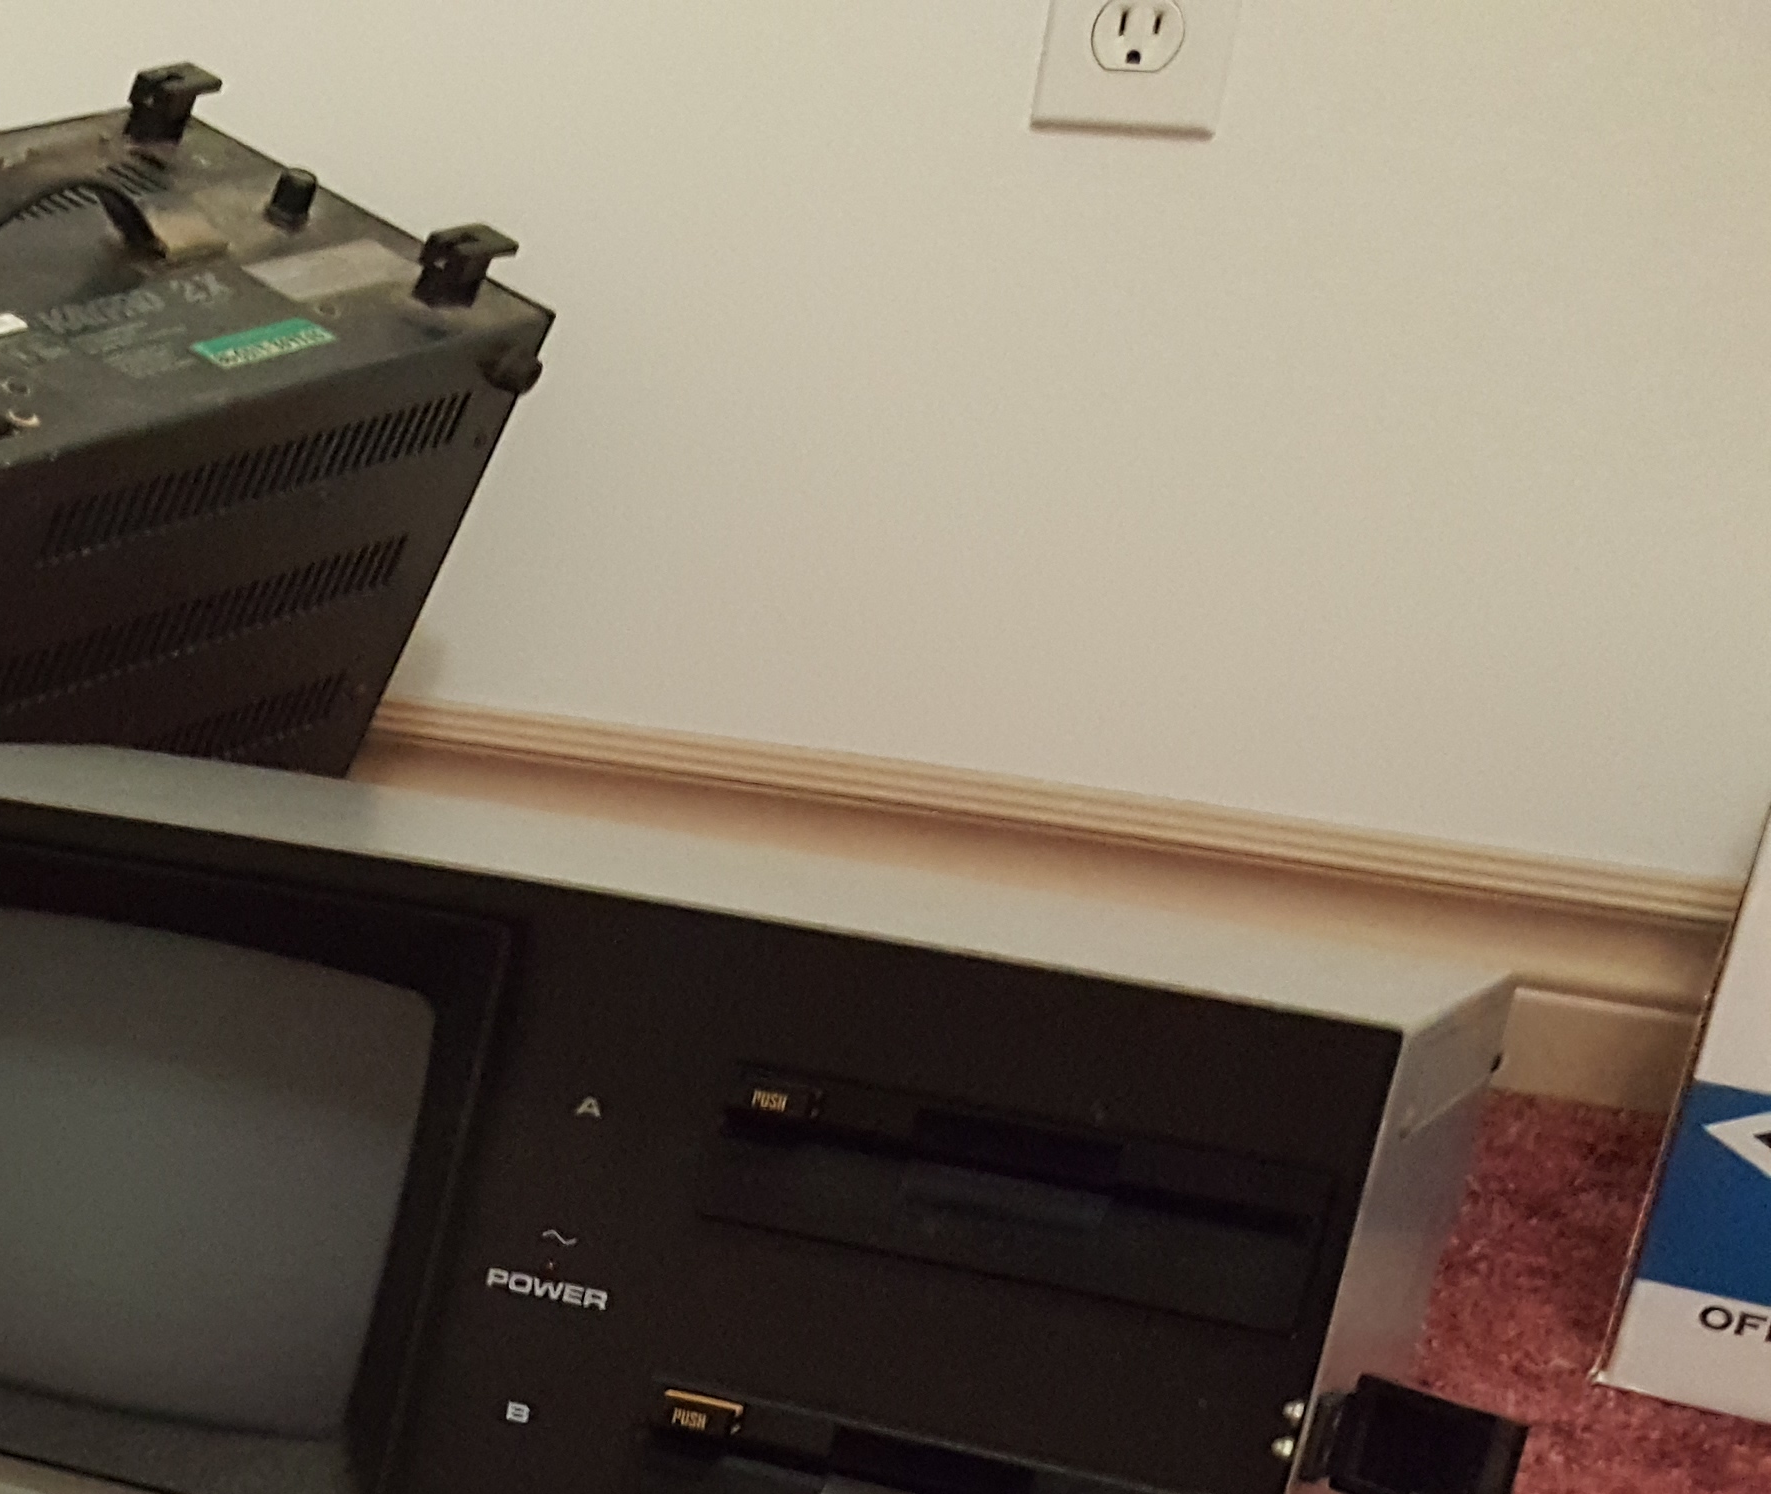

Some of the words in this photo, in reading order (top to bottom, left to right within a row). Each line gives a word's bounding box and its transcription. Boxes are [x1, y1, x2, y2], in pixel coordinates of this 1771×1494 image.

[577, 1098, 600, 1117] A
[752, 1088, 789, 1114] PUSH
[487, 1268, 607, 1310] POWER
[1699, 1305, 1771, 1343] OF
[506, 1401, 530, 1423] B
[672, 1406, 708, 1432] PUSH
